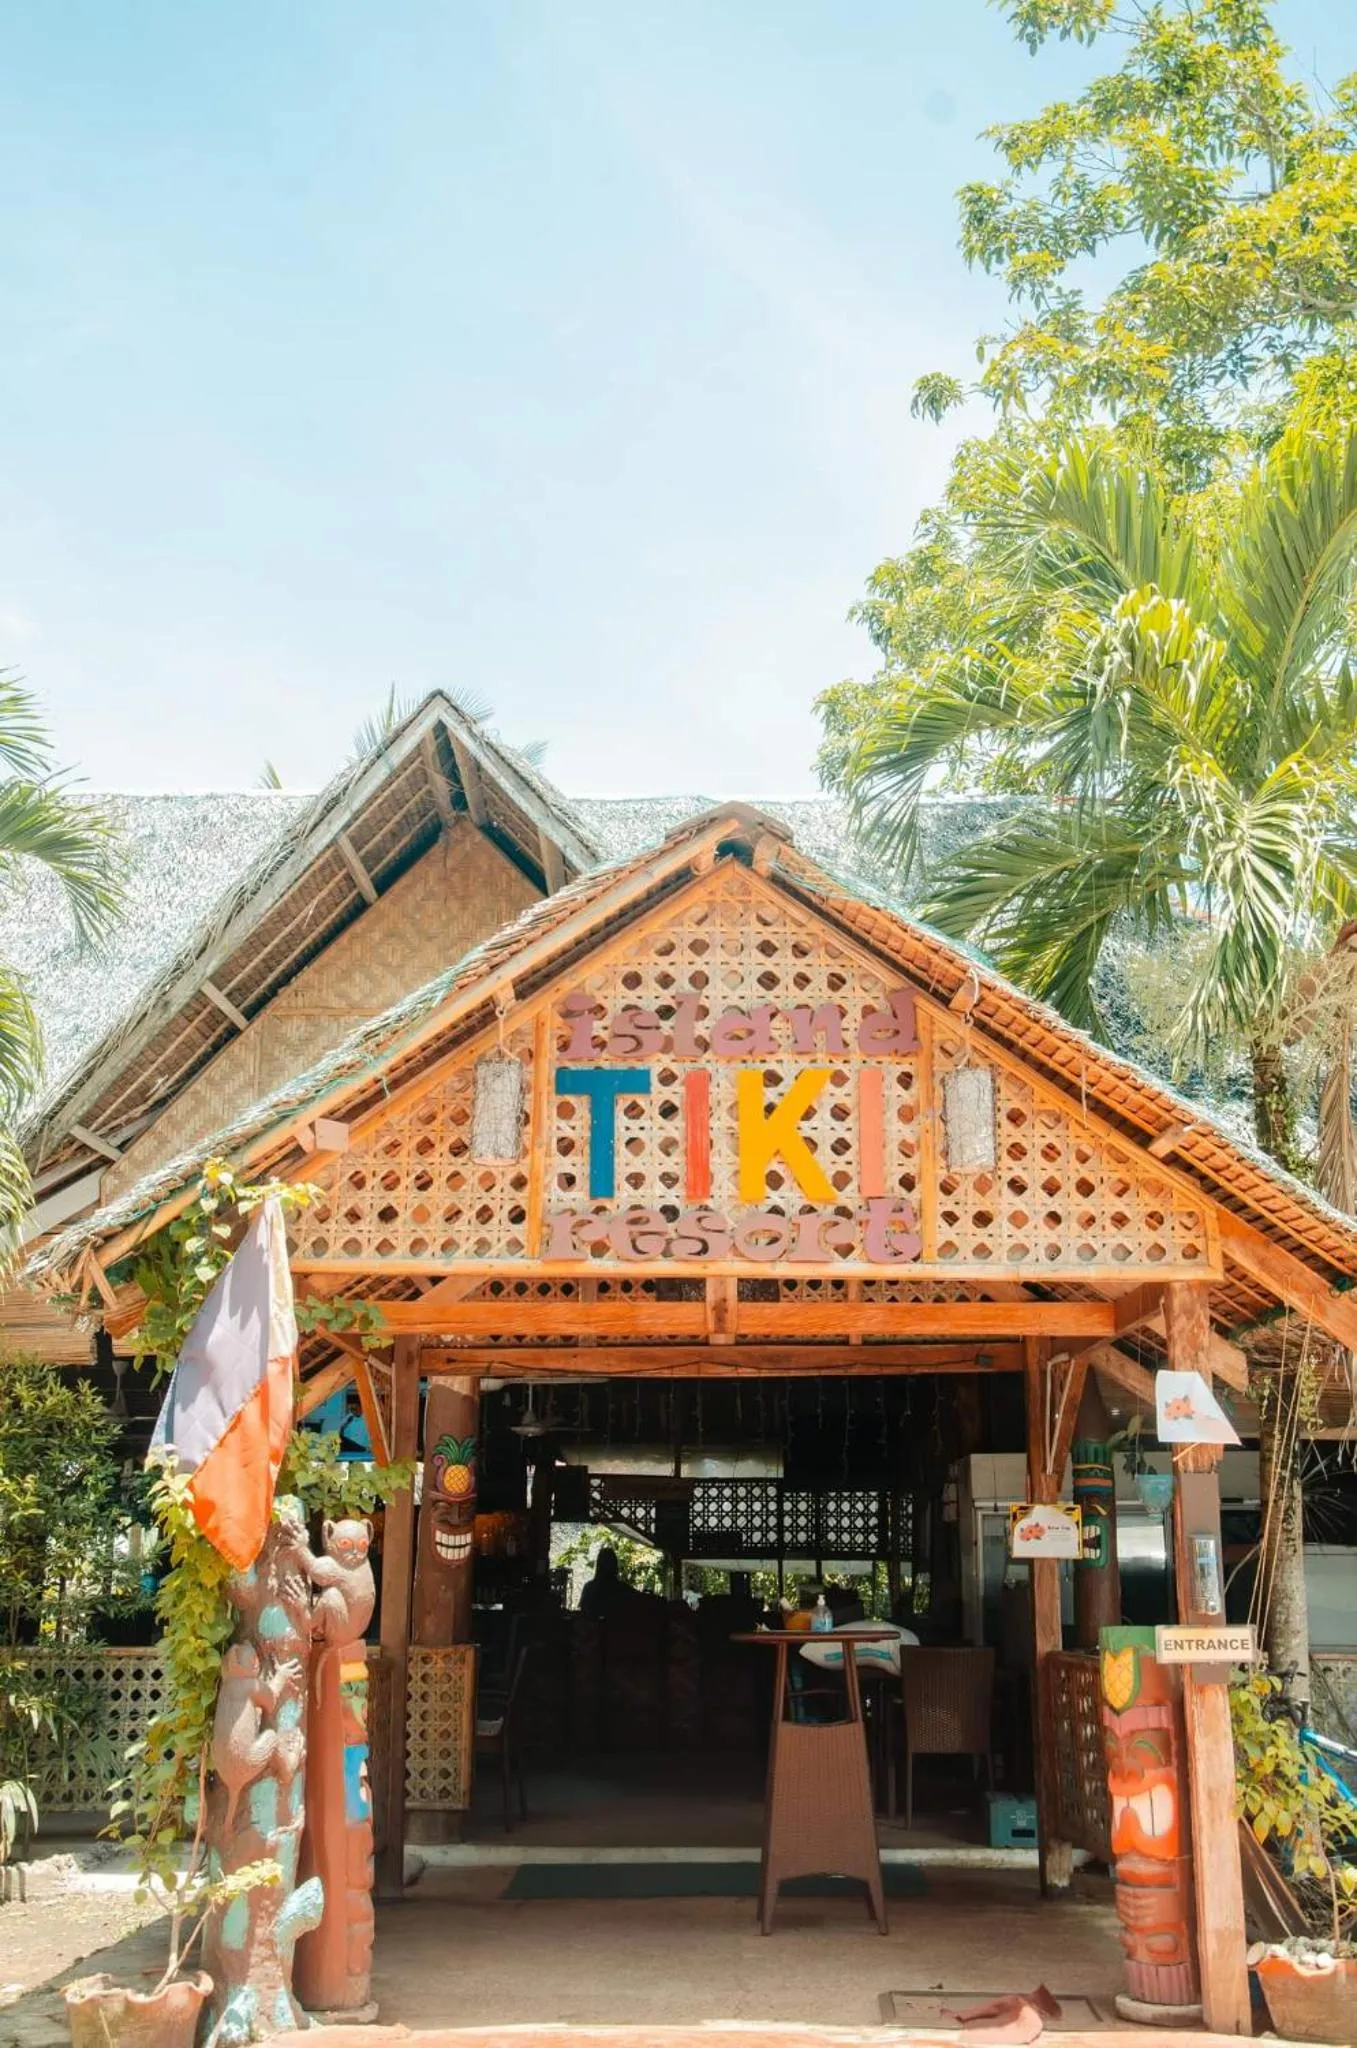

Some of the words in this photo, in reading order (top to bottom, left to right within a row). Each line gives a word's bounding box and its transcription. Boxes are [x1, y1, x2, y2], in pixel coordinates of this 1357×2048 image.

[556, 989, 922, 1059] island
[555, 1067, 885, 1204] TIKI
[541, 1197, 923, 1264] resort
[1163, 1638, 1251, 1651] ENTRANCE
